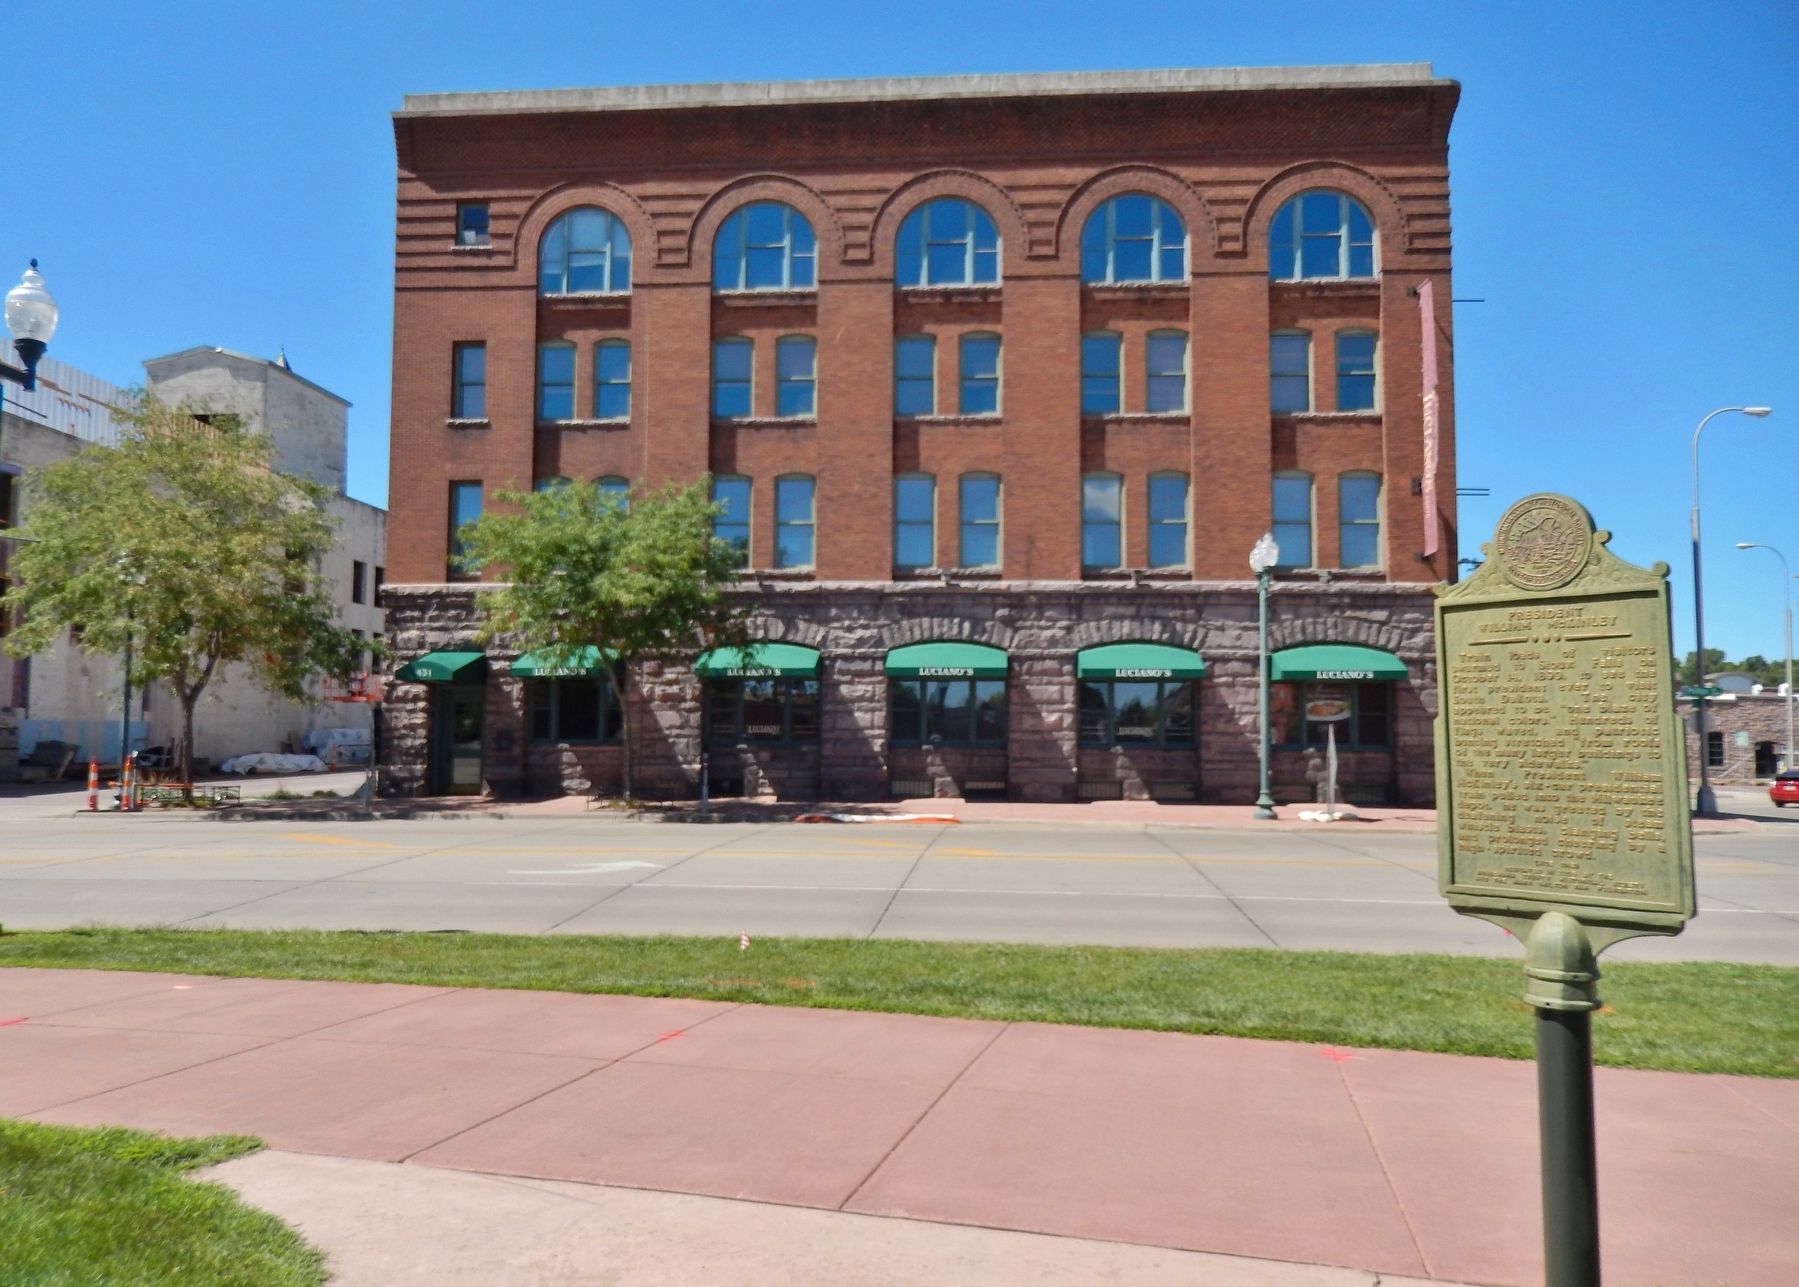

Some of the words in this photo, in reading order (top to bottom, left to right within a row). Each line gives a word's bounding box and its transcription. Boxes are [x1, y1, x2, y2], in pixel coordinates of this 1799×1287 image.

[1508, 606, 1583, 621] PRESIDENT
[1479, 621, 1532, 633] WILLIAM
[1459, 652, 1491, 663] Train
[1510, 651, 1540, 661] loads
[1563, 648, 1575, 659] of
[1600, 646, 1656, 656] visitors
[1514, 661, 1526, 671] to
[1540, 660, 1575, 671] Sioux
[1592, 657, 1623, 669] Falls
[1640, 658, 1656, 668] on
[416, 669, 432, 678] 431
[919, 667, 975, 677] LUCIANO'S
[1115, 668, 1172, 678] LUCIANO'S
[1316, 670, 1374, 680] LUCIANO'S
[1453, 672, 1500, 684] October
[1580, 670, 1592, 680] to
[1602, 669, 1626, 680] see
[1636, 667, 1656, 679] the
[1453, 684, 1478, 694] first
[1487, 682, 1547, 696] president
[1560, 682, 1588, 692] ever
[1600, 681, 1612, 691] to
[1625, 680, 1657, 691] visit
[1453, 694, 1485, 705] South
[1581, 691, 1607, 703] The
[1629, 691, 1658, 703] city
[1454, 705, 1506, 716] appeared
[1515, 704, 1526, 715] to
[1534, 704, 1550, 714] be
[1644, 702, 1658, 713] of
[1454, 716, 1500, 726] national
[1569, 713, 1633, 726] Hundreds
[1645, 713, 1659, 725] of
[1455, 726, 1484, 738] flags
[1554, 726, 1579, 737] and
[1594, 725, 1660, 738] patriotic
[1455, 738, 1498, 749] bunting
[1505, 737, 1565, 747] stretched
[1622, 737, 1661, 748] roofs
[1456, 747, 1468, 757] of
[1474, 747, 1491, 757] the
[1496, 750, 1527, 759] many
[1532, 749, 1572, 761] larger
[1578, 748, 1641, 762] buildings
[1648, 750, 1662, 760] to
[1456, 757, 1473, 768] the
[1482, 758, 1510, 770] very
[1524, 768, 1587, 781] President
[1610, 769, 1664, 783] William
[1580, 783, 1664, 795] presidential
[1491, 790, 1529, 801] pulled
[1534, 792, 1559, 802] into
[1567, 793, 1585, 803] the
[1592, 793, 1664, 806] Milwaukee
[1521, 803, 1545, 813] was
[1553, 804, 1606, 816] greeted
[1615, 806, 1634, 818] by
[1642, 806, 1664, 818] the
[1534, 813, 1568, 825] noise
[1592, 815, 1605, 827] of
[1625, 818, 1664, 830] steam
[1458, 832, 1479, 842] and
[1488, 834, 1549, 848] prolonged
[1628, 841, 1646, 854] by
